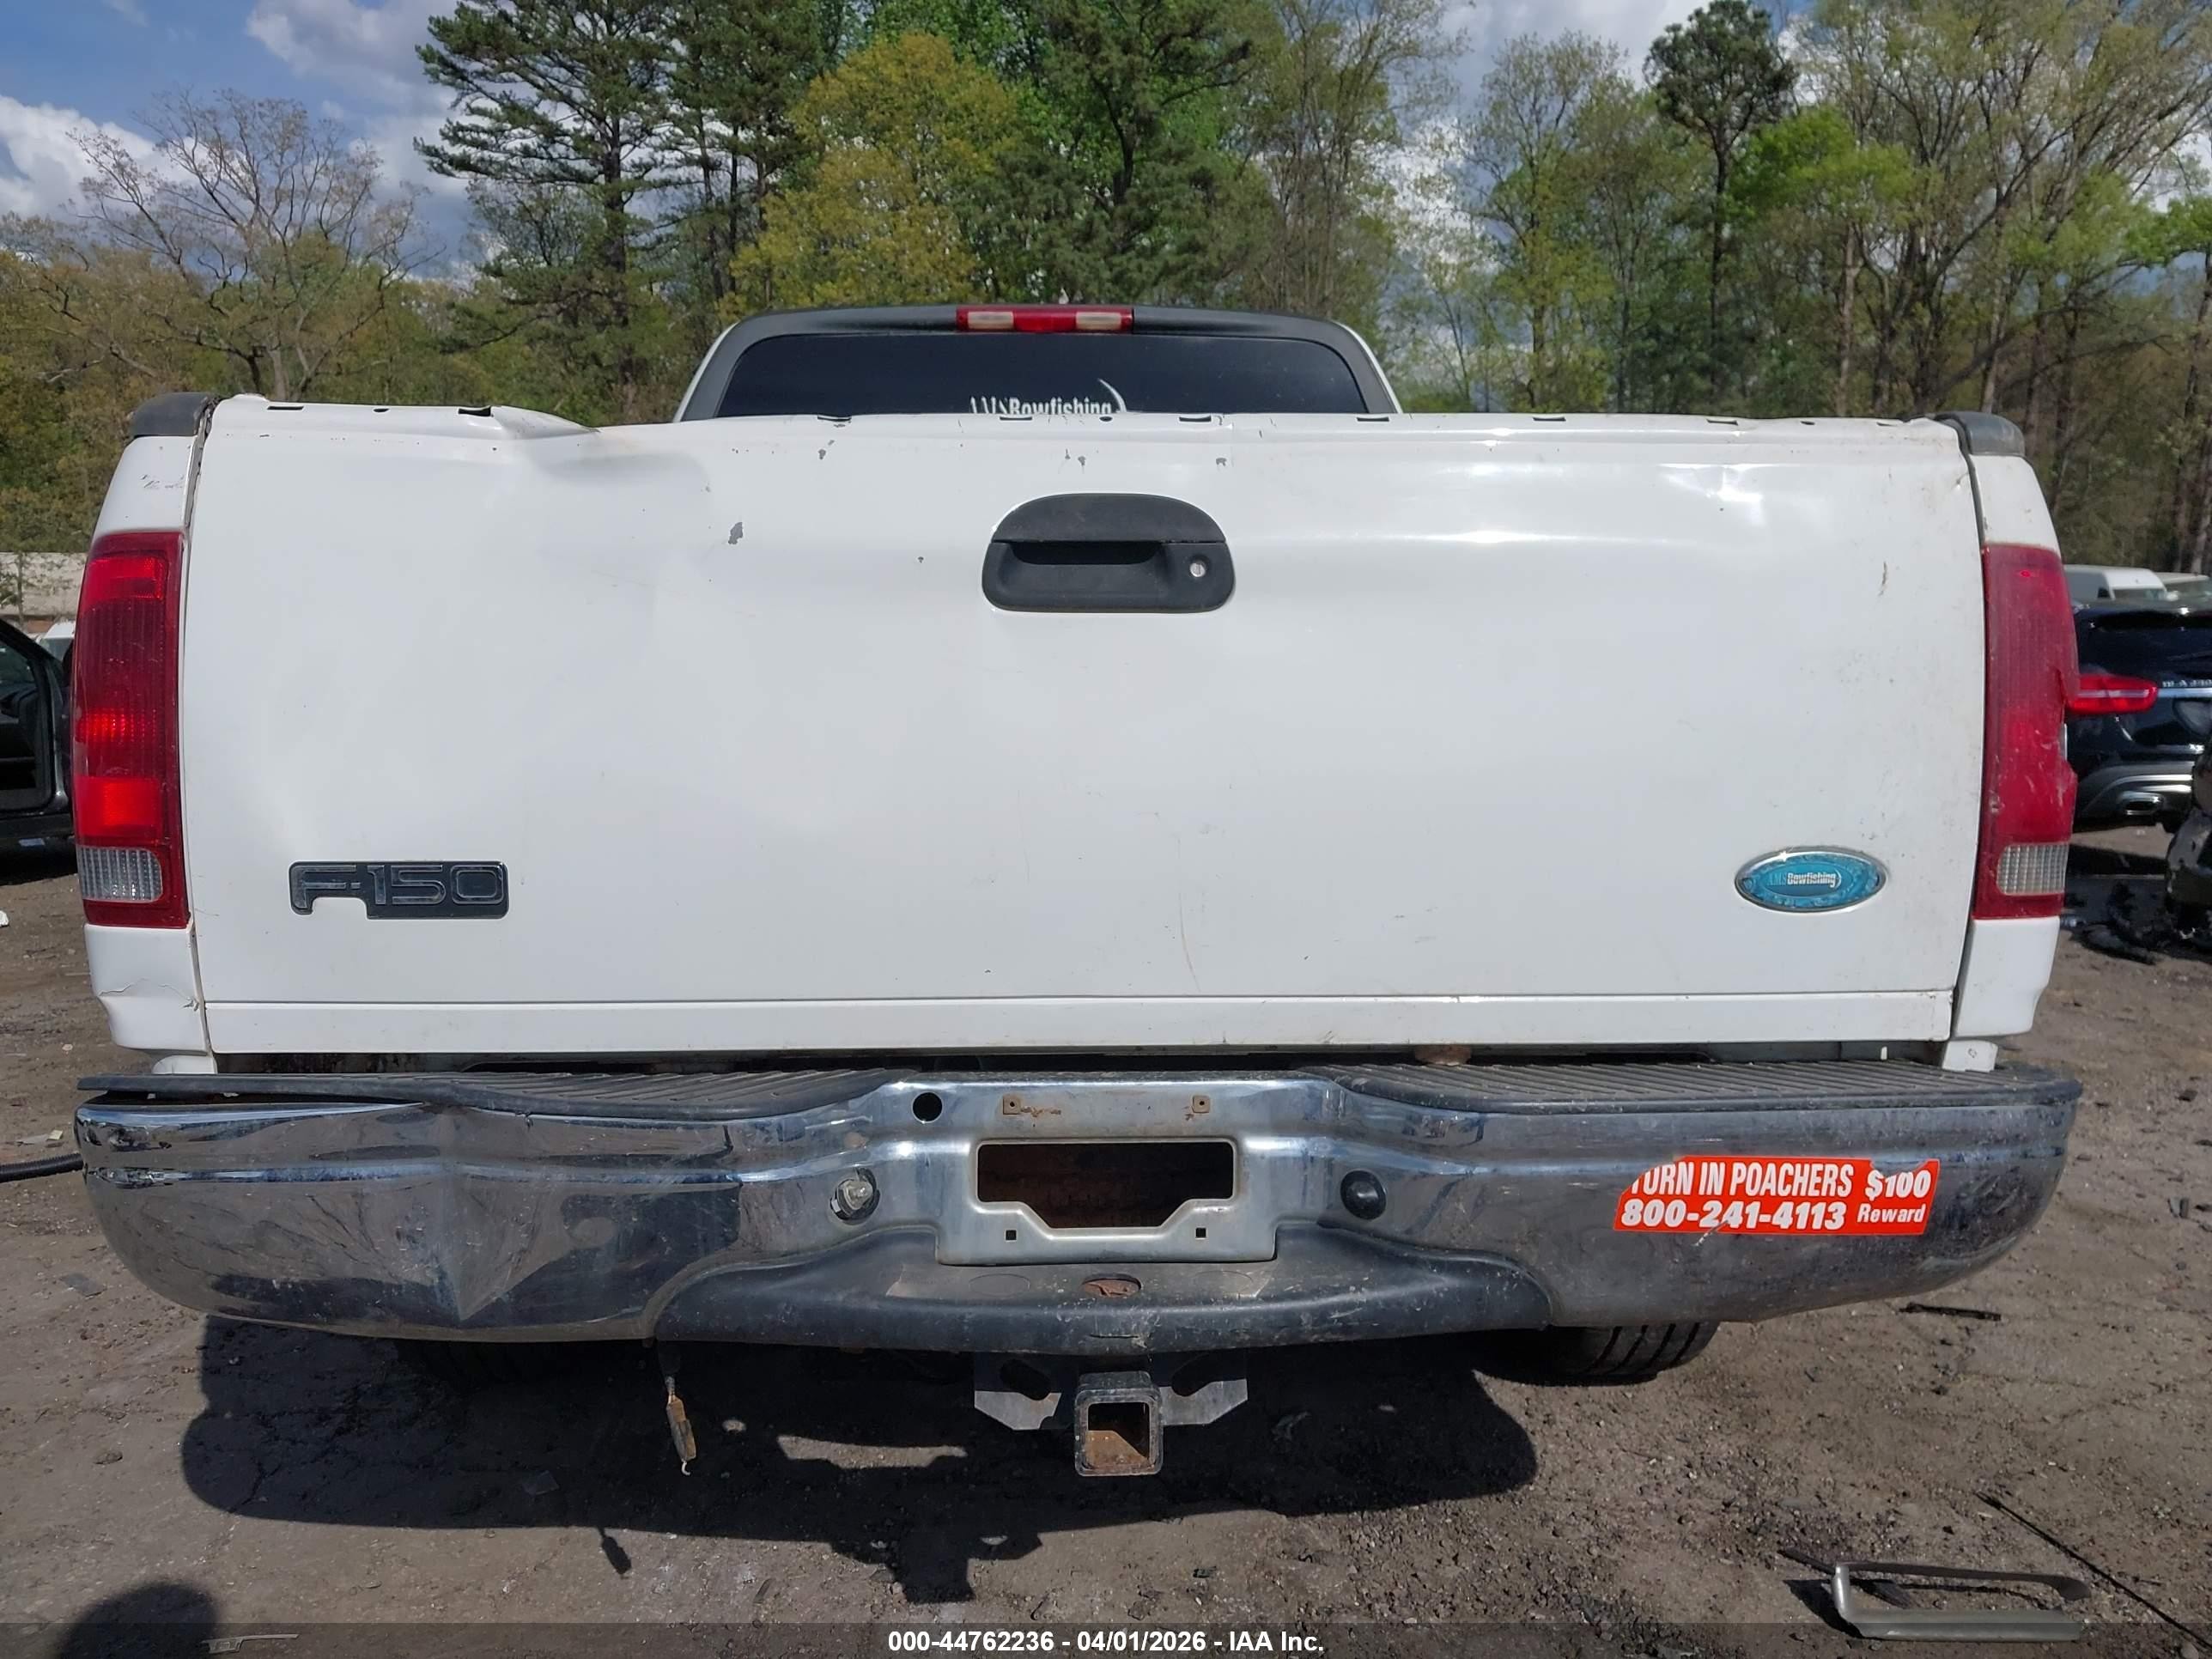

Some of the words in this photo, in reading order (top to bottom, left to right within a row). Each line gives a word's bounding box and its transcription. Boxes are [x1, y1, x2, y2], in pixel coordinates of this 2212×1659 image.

[1009, 397, 1112, 415] Bowfishing
[290, 864, 505, 908] F-150
[1698, 1162, 1726, 1195] IN
[1729, 1162, 1854, 1197] POACHERS
[1865, 1170, 1931, 1201] $100
[1621, 1199, 1847, 1230] 800-241-4113
[1856, 1203, 1926, 1223] Reward
